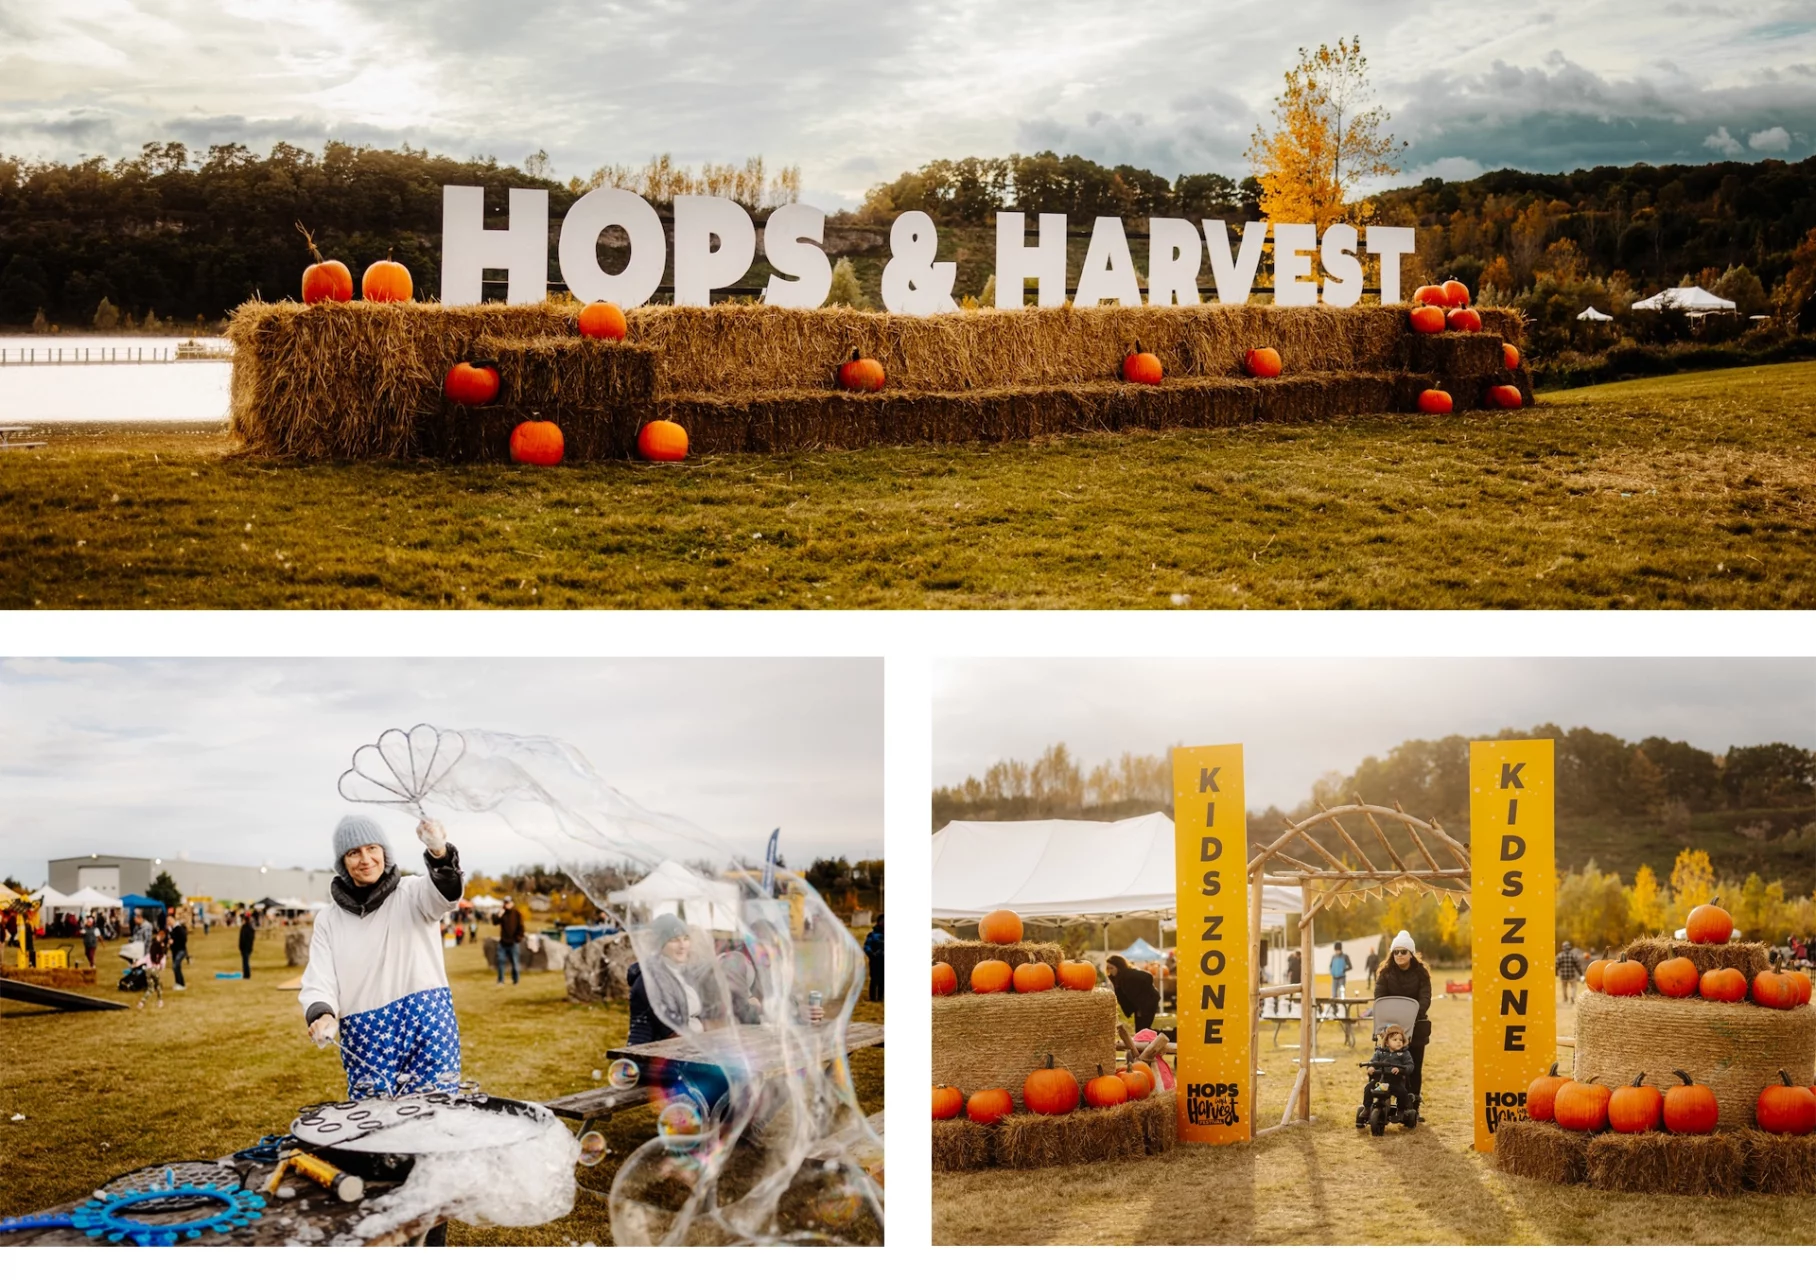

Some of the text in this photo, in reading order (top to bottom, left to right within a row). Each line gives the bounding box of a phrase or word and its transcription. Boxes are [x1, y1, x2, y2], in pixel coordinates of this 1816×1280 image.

[441, 185, 1416, 316] HOPS & HARVEST
[1200, 767, 1227, 1045] KIDS ZONE
[1499, 763, 1528, 1052] KIDS ZONE
[1187, 1083, 1239, 1098] HOPS
[1187, 1098, 1239, 1126] Harvest
[1486, 1092, 1528, 1107] HOP
